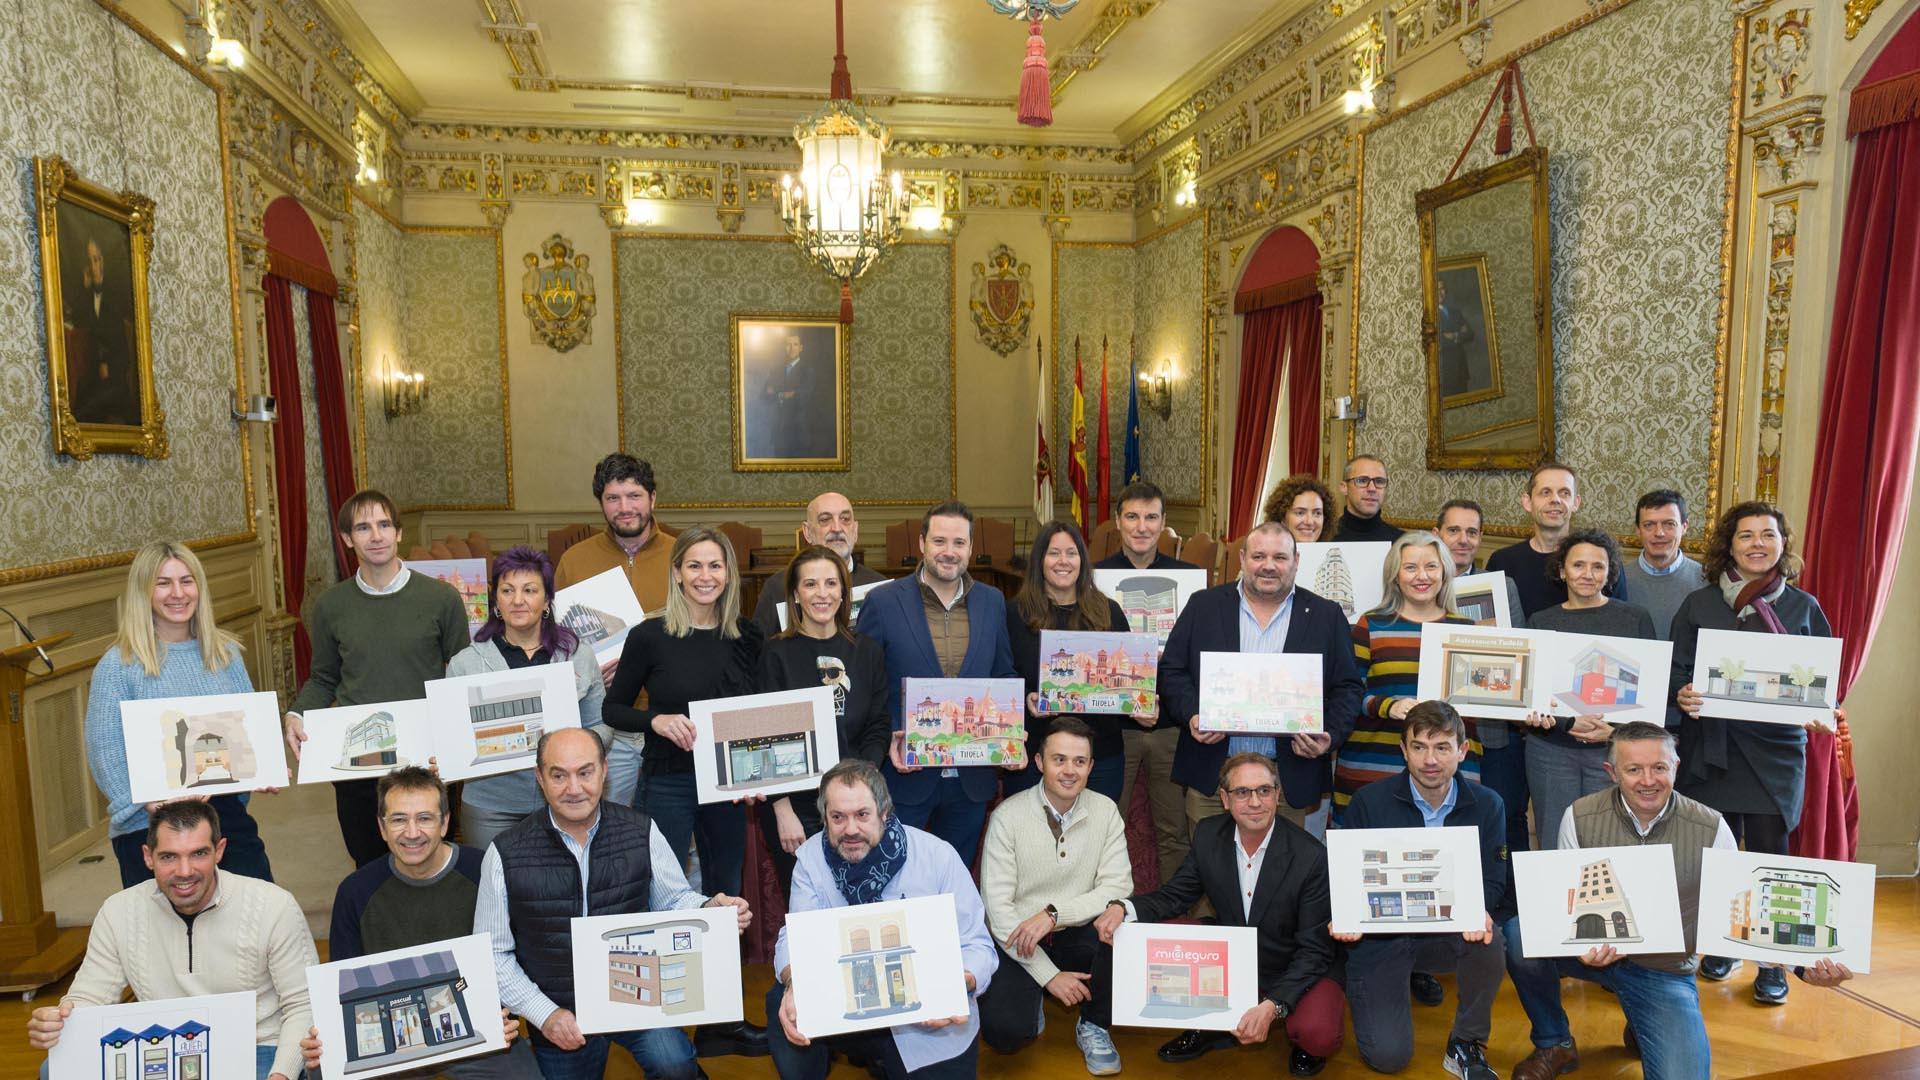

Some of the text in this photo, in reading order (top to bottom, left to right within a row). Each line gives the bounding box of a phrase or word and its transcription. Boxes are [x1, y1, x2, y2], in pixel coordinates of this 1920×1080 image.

[1092, 699, 1115, 707] TUDELA
[960, 750, 984, 759] TUDELA
[389, 994, 412, 1006] pascual
